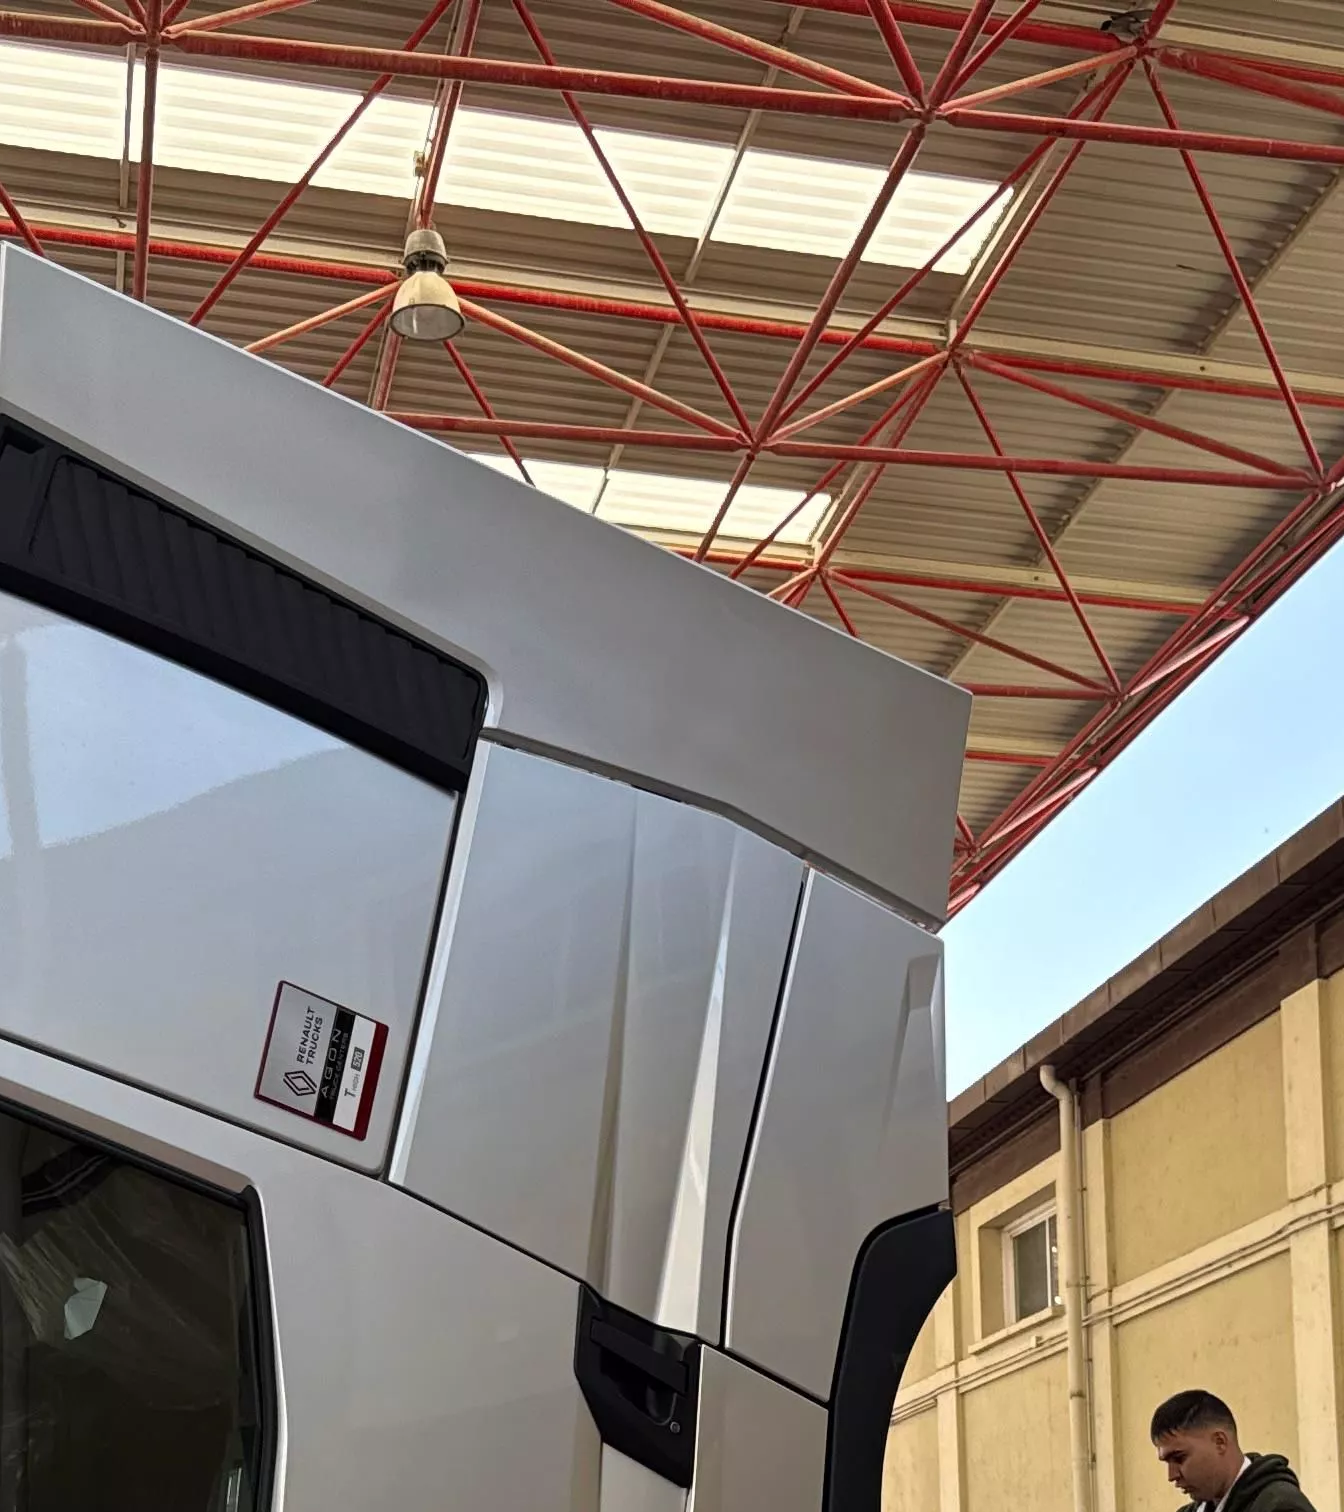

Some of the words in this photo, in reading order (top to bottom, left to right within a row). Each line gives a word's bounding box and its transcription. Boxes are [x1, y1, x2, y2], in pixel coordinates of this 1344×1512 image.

[296, 1005, 316, 1063] RENAULT
[305, 1016, 323, 1065] TRUCKS
[352, 1051, 364, 1069] 520
[320, 1028, 342, 1099] AGON
